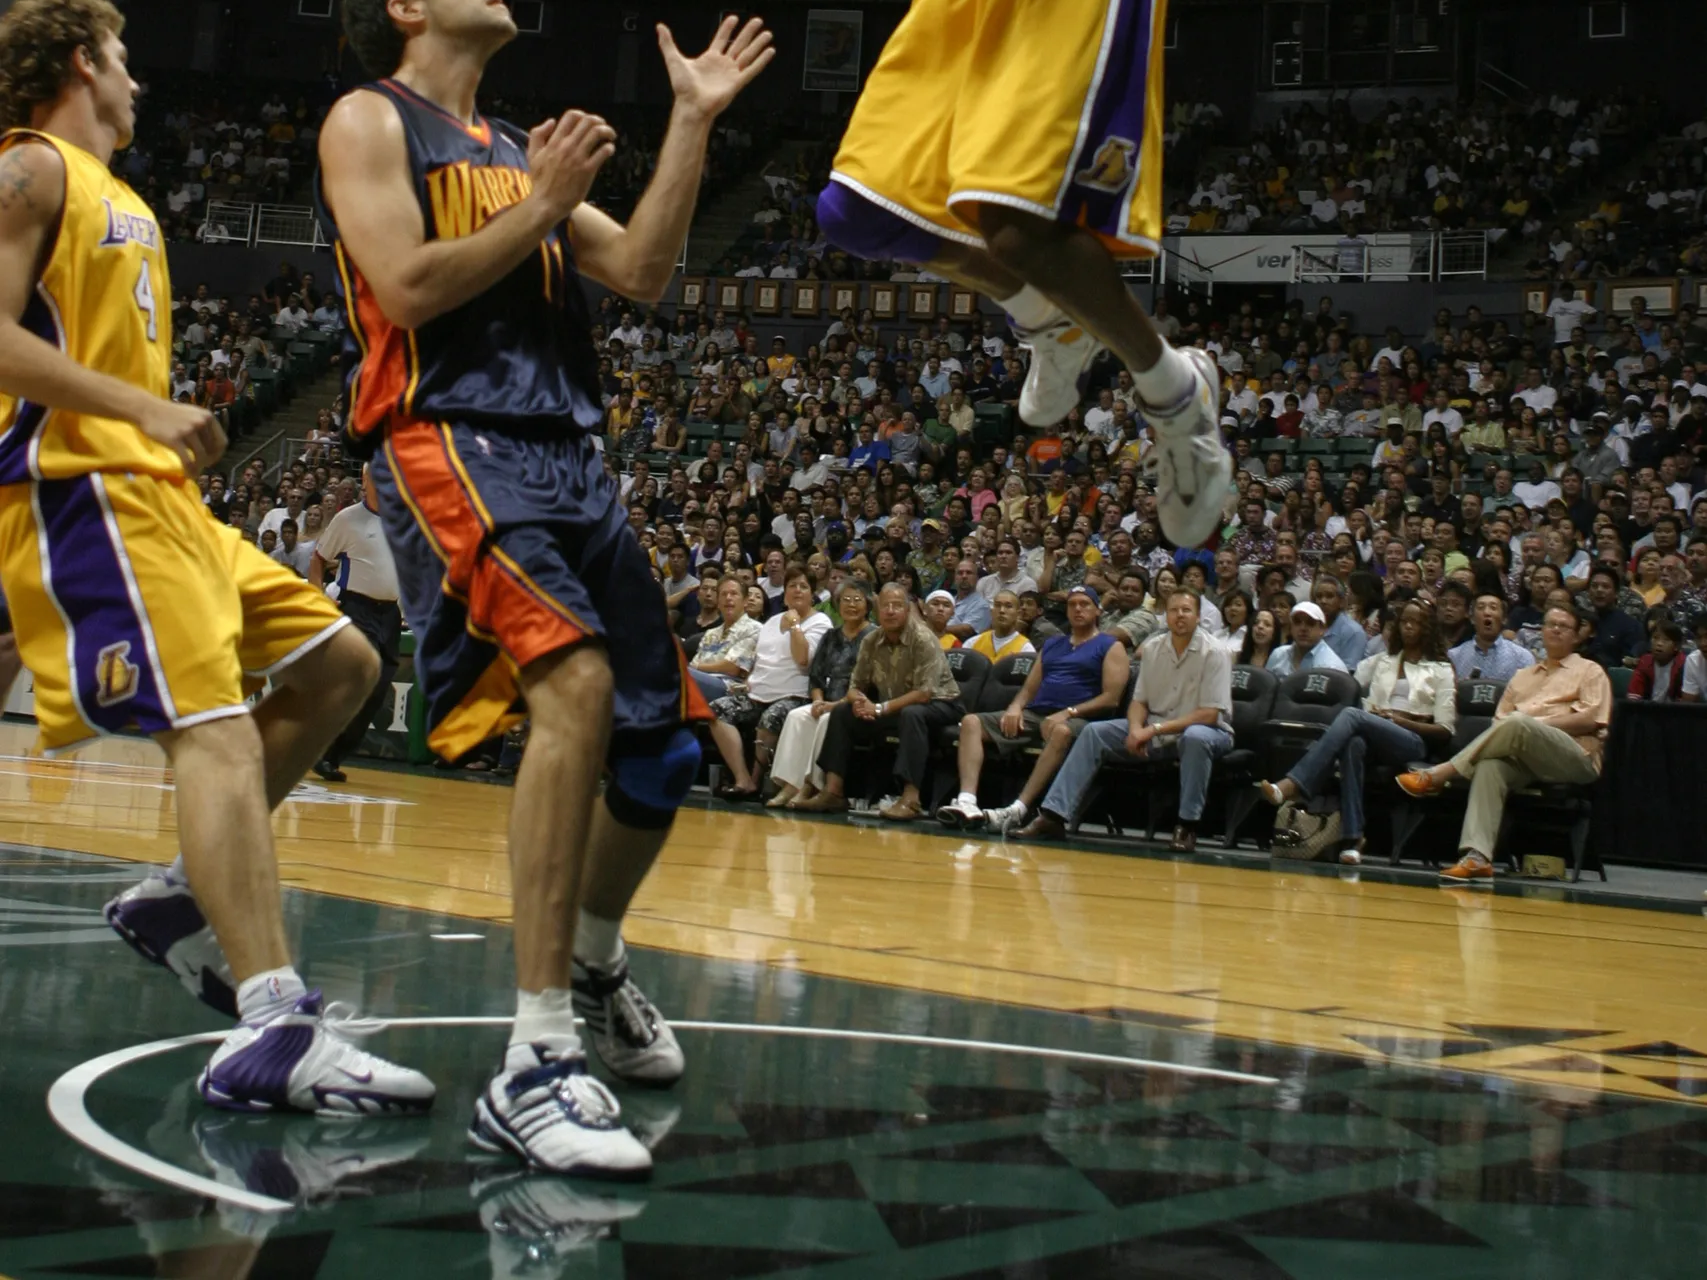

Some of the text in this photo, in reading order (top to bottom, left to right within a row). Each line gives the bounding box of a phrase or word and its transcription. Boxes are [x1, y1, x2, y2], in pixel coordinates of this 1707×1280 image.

[132, 256, 158, 343] 4
[1303, 674, 1330, 694] H
[1469, 684, 1496, 704] H
